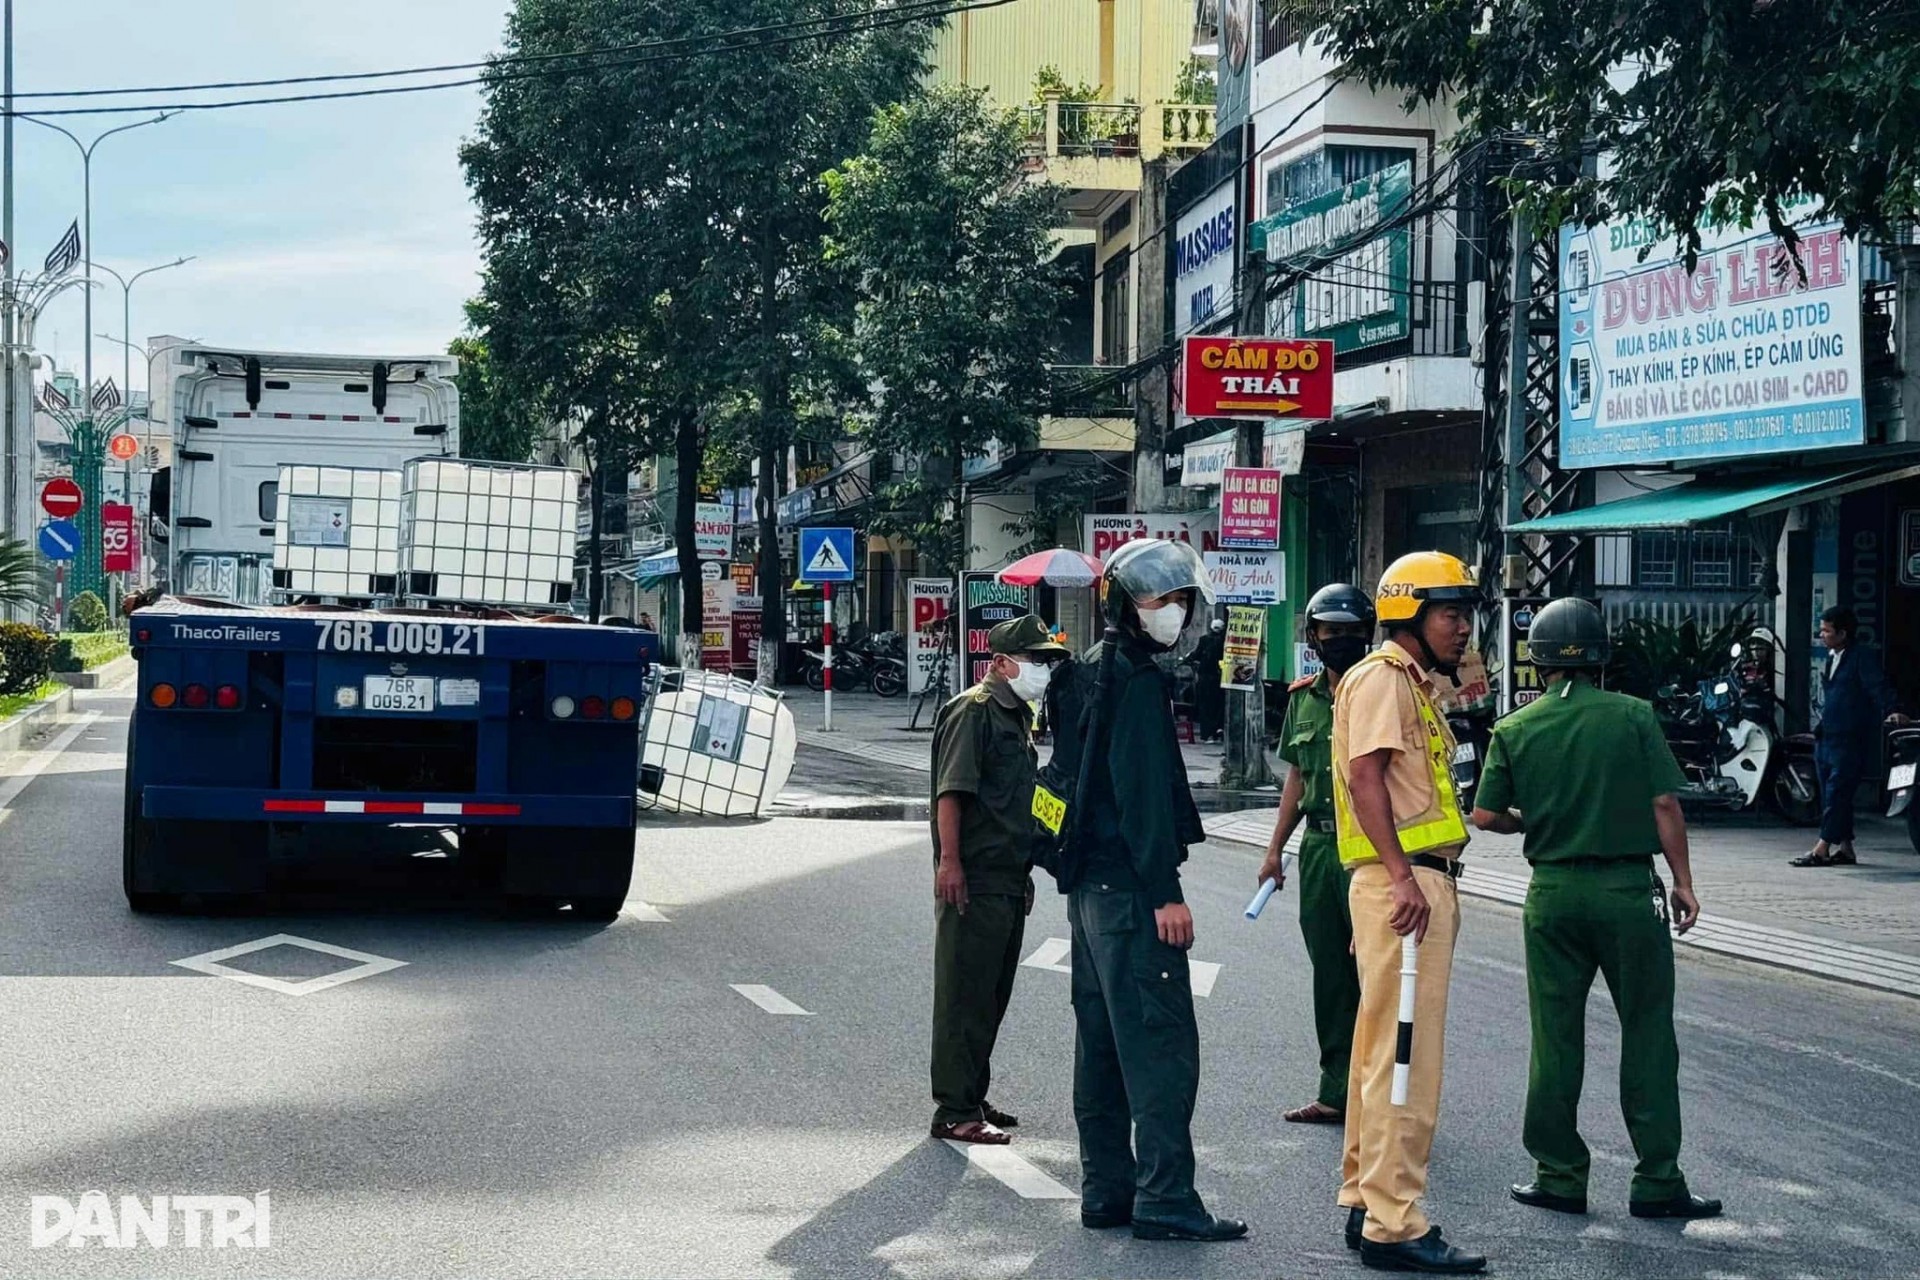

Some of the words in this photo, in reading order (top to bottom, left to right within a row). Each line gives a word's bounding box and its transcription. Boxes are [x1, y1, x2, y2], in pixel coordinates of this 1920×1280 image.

[1176, 205, 1233, 278] MASSAGE
[1616, 335, 1645, 358] MUA
[1648, 324, 1678, 354] BÁN
[1682, 326, 1692, 348] &
[1201, 340, 1268, 369] CẦM
[1275, 342, 1319, 371] ĐỒ
[1608, 365, 1640, 389] THAY
[1644, 356, 1678, 384] KÍNH,
[1681, 352, 1699, 379] ÉP
[1703, 347, 1741, 376] KÍNH,
[1744, 341, 1764, 370] ÉP
[1768, 332, 1803, 366] CẢM
[1808, 331, 1844, 360] ỨNG
[1221, 371, 1300, 395] THÁI
[1606, 391, 1633, 421] BÁN
[1692, 379, 1722, 412] CÁC
[1762, 375, 1790, 403] SIM
[1803, 367, 1849, 399] CARD
[1093, 518, 1132, 529] HƯƠNG
[1219, 554, 1241, 566] NHÀ
[1244, 556, 1267, 566] MAY
[968, 581, 1028, 609] MASSAGE
[1378, 583, 1415, 599] SGT
[982, 607, 1014, 620] MOTEL
[170, 624, 281, 642] ThacoTrailers
[385, 679, 415, 694] 76R
[372, 694, 426, 710] 009.21
